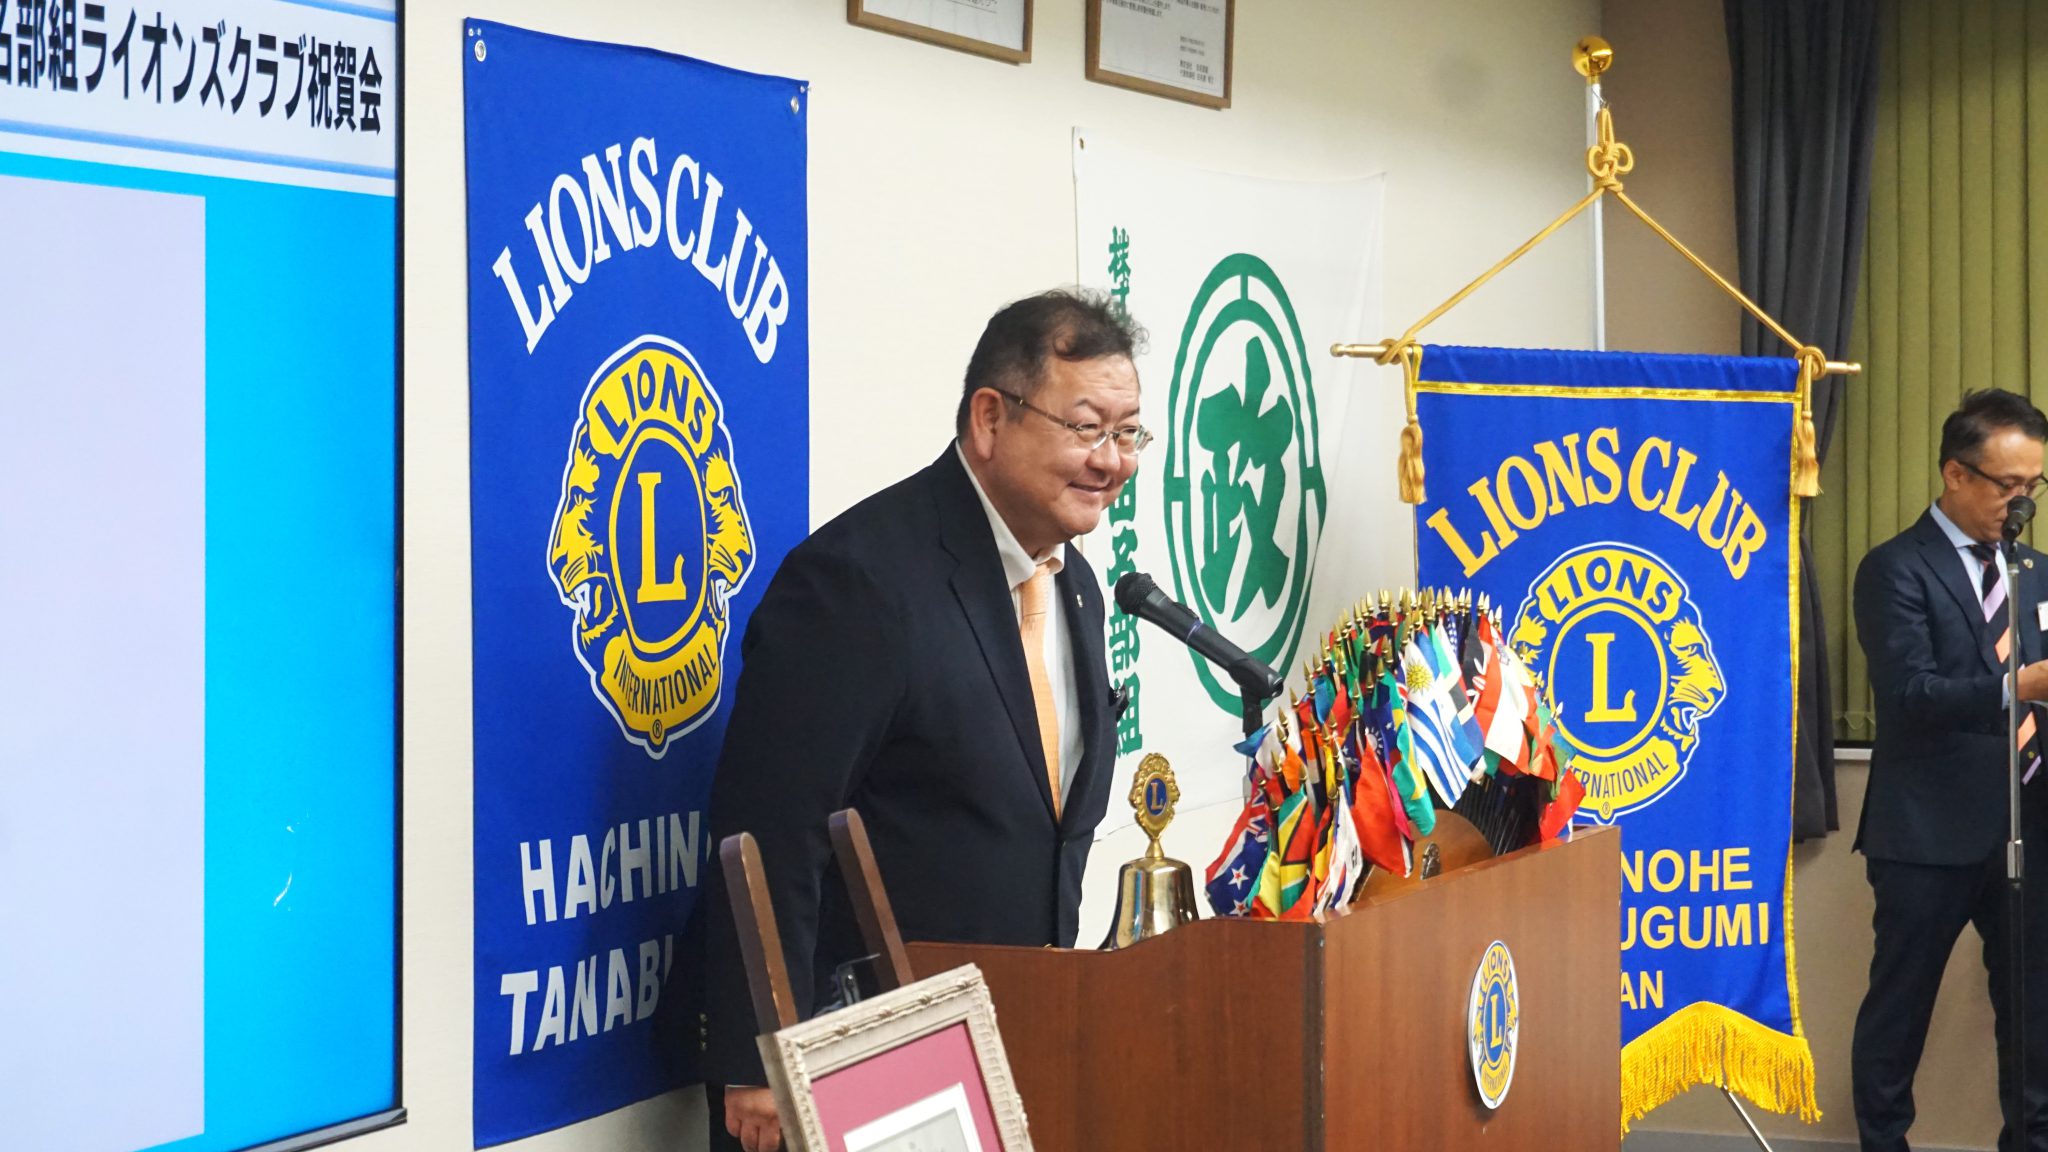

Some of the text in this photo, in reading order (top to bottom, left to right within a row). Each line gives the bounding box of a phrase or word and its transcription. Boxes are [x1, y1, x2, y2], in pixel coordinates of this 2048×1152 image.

[492, 136, 789, 364] LIONS CLUB
[594, 359, 714, 445] LIONS
[637, 472, 687, 604] L
[1426, 427, 1622, 579] LIONS
[1628, 437, 1767, 580] CLUB
[1546, 557, 1673, 614] LIONS
[613, 643, 716, 715] INTERNATIONAL
[1584, 633, 1637, 722] L
[1570, 752, 1669, 798] RNATIONAL
[520, 811, 712, 925] HACHIN
[1482, 951, 1509, 984] LIONS
[1490, 993, 1502, 1049] L
